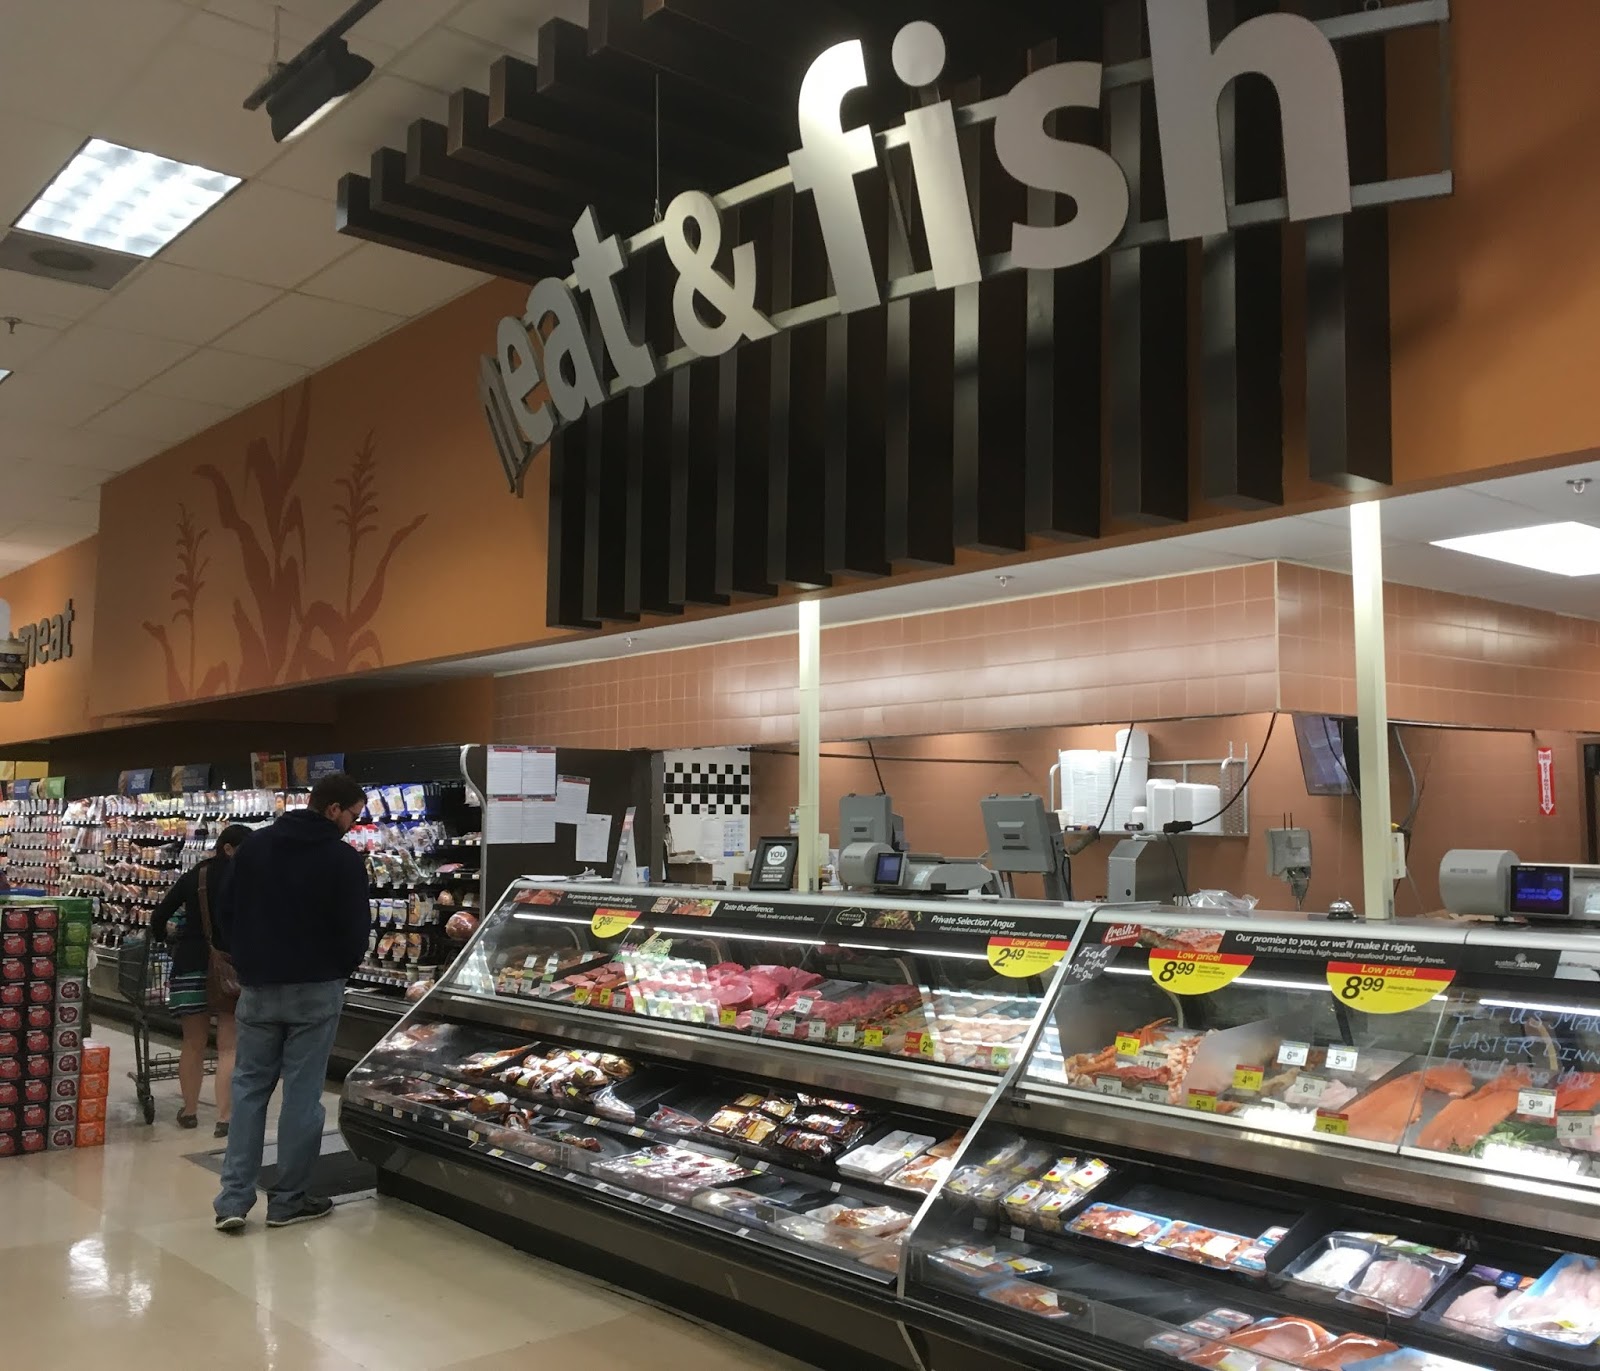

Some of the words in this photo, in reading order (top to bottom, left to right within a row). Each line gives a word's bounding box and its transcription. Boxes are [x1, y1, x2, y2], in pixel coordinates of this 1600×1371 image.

[479, 204, 656, 498] meat
[663, 189, 779, 357] &
[788, 0, 1352, 314] fish
[723, 902, 737, 911] Taste
[737, 903, 746, 911] the
[746, 904, 775, 913] difference.
[931, 915, 956, 924] Private
[956, 916, 989, 926] Selection
[991, 918, 1016, 929] Angus
[1010, 938, 1026, 946] Low
[1026, 940, 1049, 948] price!
[1235, 933, 1251, 942] Our
[1251, 935, 1287, 945] promise
[1288, 937, 1298, 945] to
[1298, 939, 1318, 948] you,
[1332, 940, 1354, 949] we'll
[1354, 940, 1381, 950] make
[1381, 942, 1390, 951] it
[1390, 943, 1417, 954] right.
[1078, 945, 1112, 959] Fresh
[1176, 951, 1195, 960] Low
[1196, 953, 1223, 962] price!
[1272, 946, 1286, 954] find
[1316, 949, 1356, 959] high-quality
[1356, 952, 1385, 960] seafood
[1402, 955, 1425, 964] family
[1425, 956, 1447, 965] loves.
[1360, 964, 1384, 974] Low
[1385, 966, 1417, 977] price!
[1509, 1005, 1543, 1029] US
[1448, 1021, 1535, 1057] EASTER
